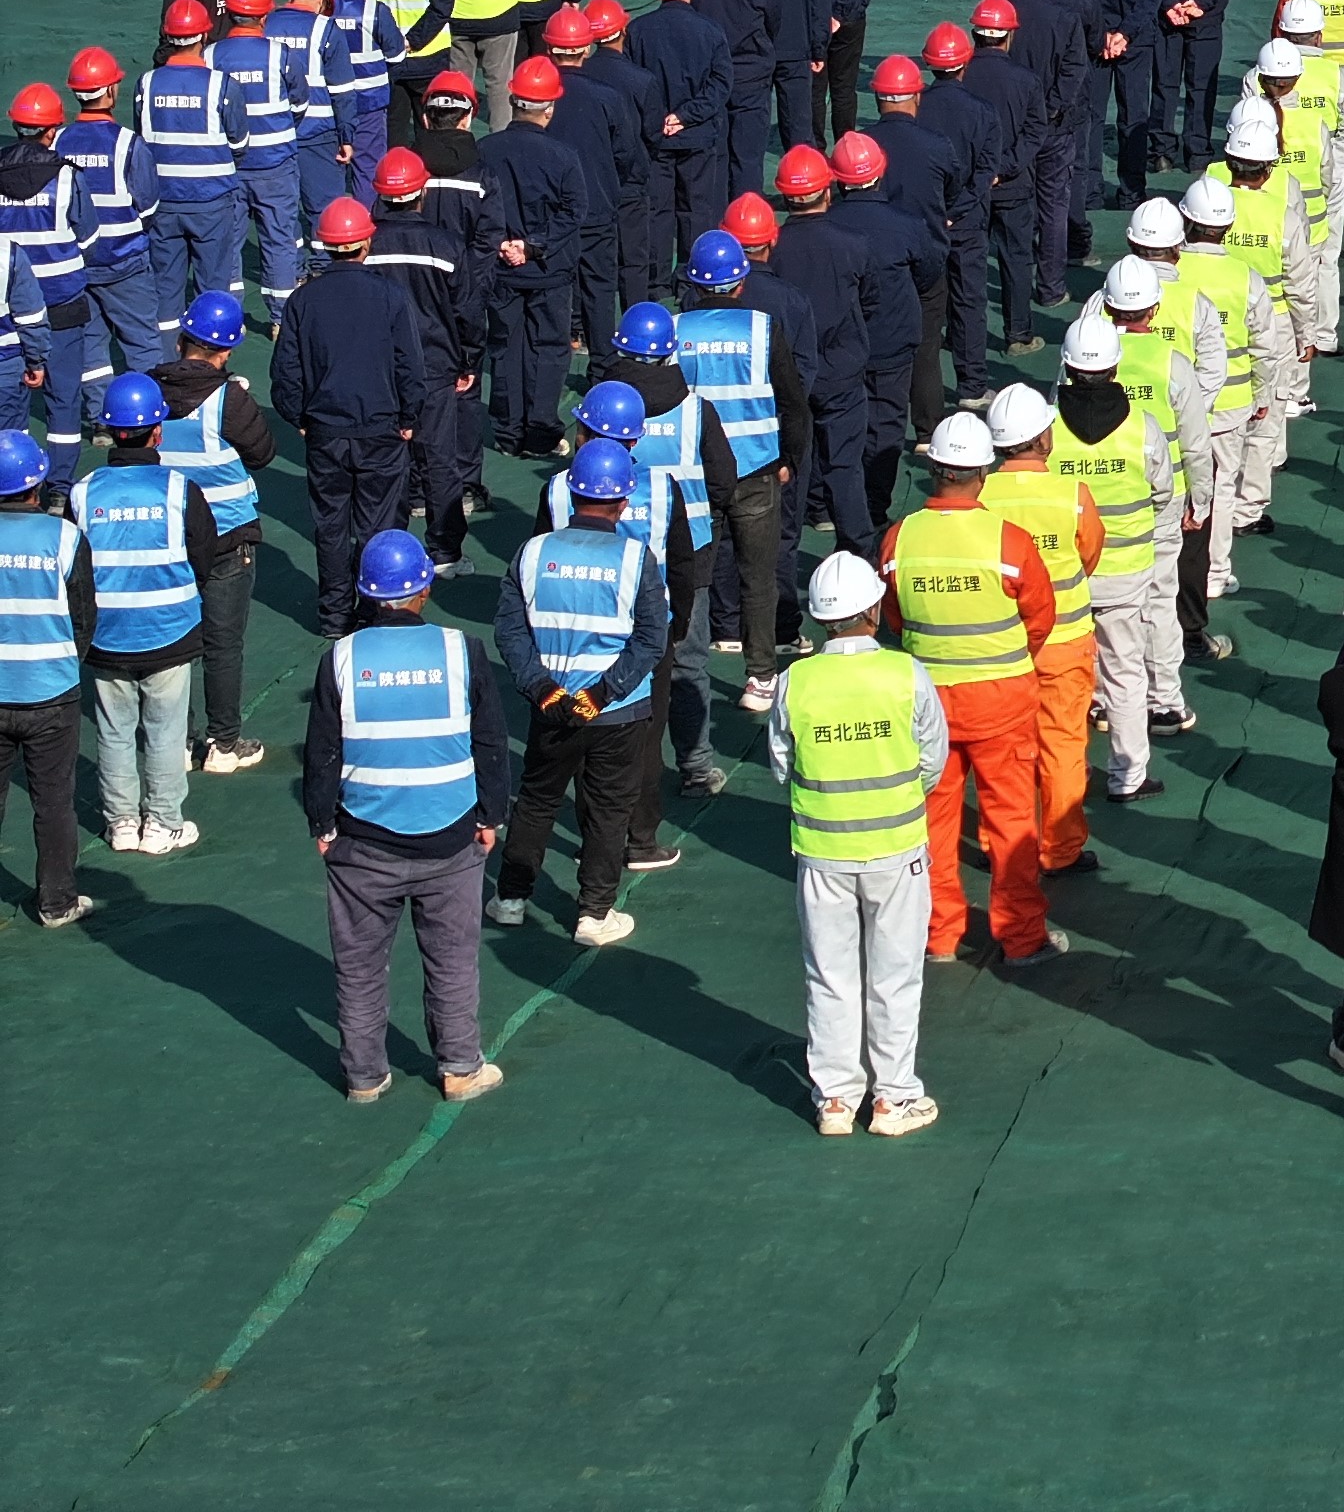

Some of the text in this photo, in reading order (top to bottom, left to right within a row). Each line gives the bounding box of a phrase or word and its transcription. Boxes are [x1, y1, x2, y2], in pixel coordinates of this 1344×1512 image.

[697, 341, 749, 354] 陕煤建设
[643, 422, 676, 436] 建设
[1060, 458, 1126, 476] 西北监理
[109, 506, 164, 522] 陕煤建设
[560, 564, 617, 582] 陕煤建设
[912, 574, 982, 593] 西北监理
[378, 668, 444, 687] 陕煤建设
[813, 719, 893, 745] 西北监理
